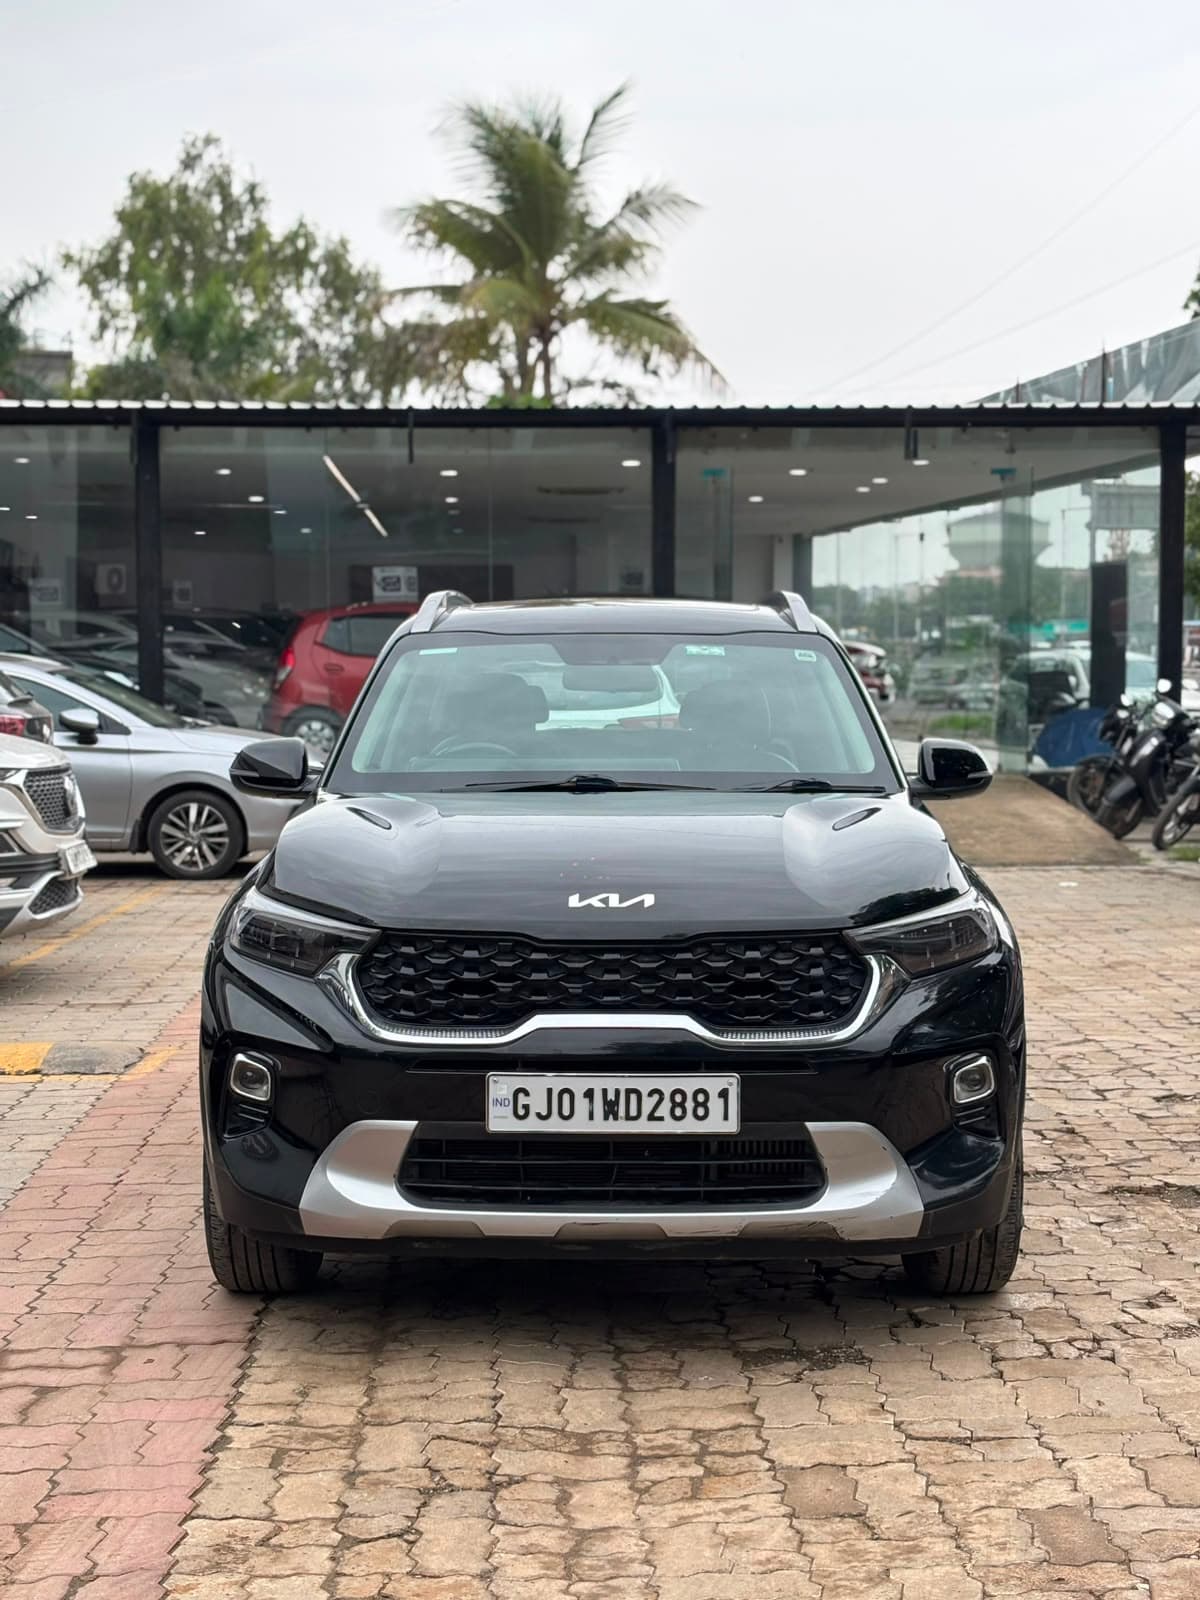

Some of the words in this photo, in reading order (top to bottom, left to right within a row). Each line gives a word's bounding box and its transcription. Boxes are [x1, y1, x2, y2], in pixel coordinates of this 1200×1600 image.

[568, 893, 655, 908] KIA
[492, 1097, 511, 1108] IND
[512, 1086, 729, 1121] GJ01WD2881
